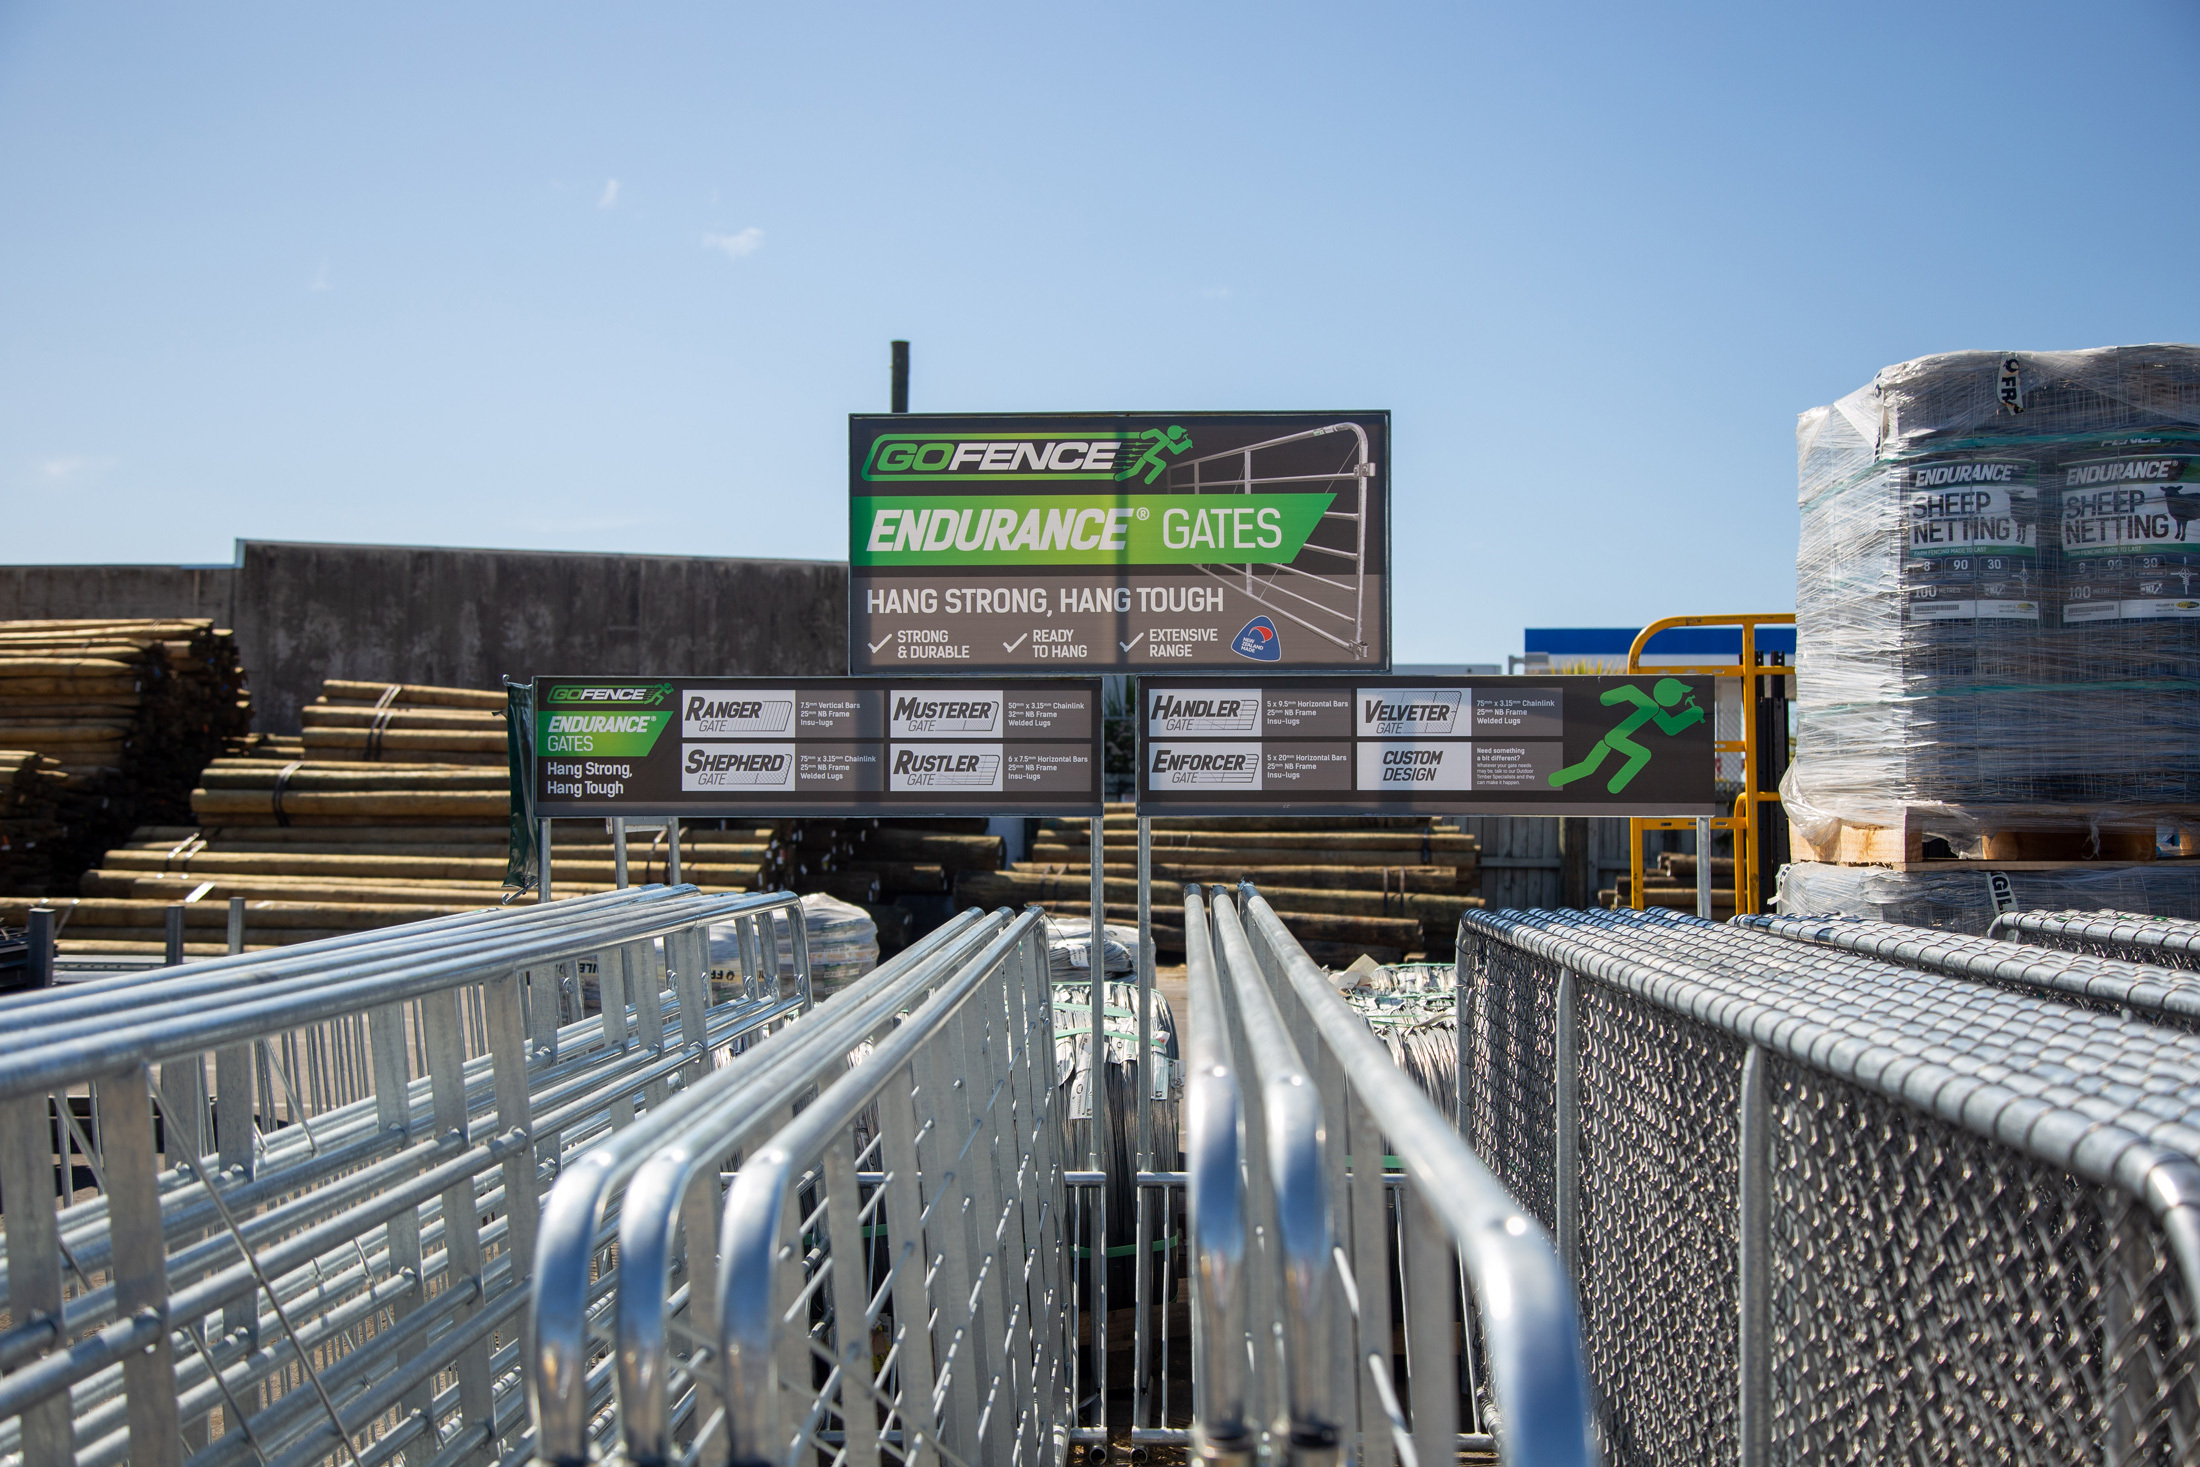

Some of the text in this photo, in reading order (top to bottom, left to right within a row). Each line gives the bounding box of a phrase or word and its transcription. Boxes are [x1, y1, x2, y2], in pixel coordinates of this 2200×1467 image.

[876, 442, 1122, 472] GOFENCE
[1913, 492, 1991, 519] SHEEP
[2066, 490, 2144, 518] SHEEP
[866, 507, 1282, 552] ENDURANCE® GATES
[1914, 517, 2010, 544] NETTING
[2066, 514, 2169, 544] NETTING
[1924, 561, 1930, 572] 8
[1954, 560, 1968, 570] 90
[1988, 559, 2001, 569] 30
[867, 587, 1223, 617] HANG STRONG, HANG TOUGH
[898, 630, 948, 643] STRONG
[1033, 630, 1074, 642] READY
[1150, 629, 1218, 641] EXTENSIVE
[897, 645, 970, 658] & DURABLE
[1032, 645, 1087, 658] TO HANG
[1150, 644, 1192, 657] RANGE
[1242, 642, 1264, 650] ZEALAND
[553, 689, 647, 700] GOFENCE
[685, 696, 762, 721] RANGER
[893, 697, 992, 721] MUSTERER
[1151, 695, 1241, 720] HANDLER
[1365, 700, 1450, 723] VELVETER
[698, 720, 728, 732] GATE
[800, 719, 833, 727] Insu-lugs
[908, 720, 936, 732] GATE
[1035, 720, 1051, 728] Lugs
[1166, 719, 1194, 731] GATE
[1267, 718, 1300, 726] Insu-lugs
[1376, 722, 1404, 734] GATE
[548, 736, 593, 751] GATES
[684, 749, 785, 774] SHEPHERD
[893, 750, 980, 774] RUSTLER
[1152, 750, 1246, 773] ENFORCER
[1383, 750, 1443, 765] CUSTOM
[547, 762, 632, 778] Hang Strong,
[828, 772, 843, 781] Lugs
[1383, 768, 1437, 781] DESIGN
[698, 773, 728, 785] GATE
[907, 773, 936, 786] GATE
[1008, 773, 1041, 781] Insu-lugs
[1172, 772, 1199, 784] GATE
[547, 781, 624, 798] Hang Tough
